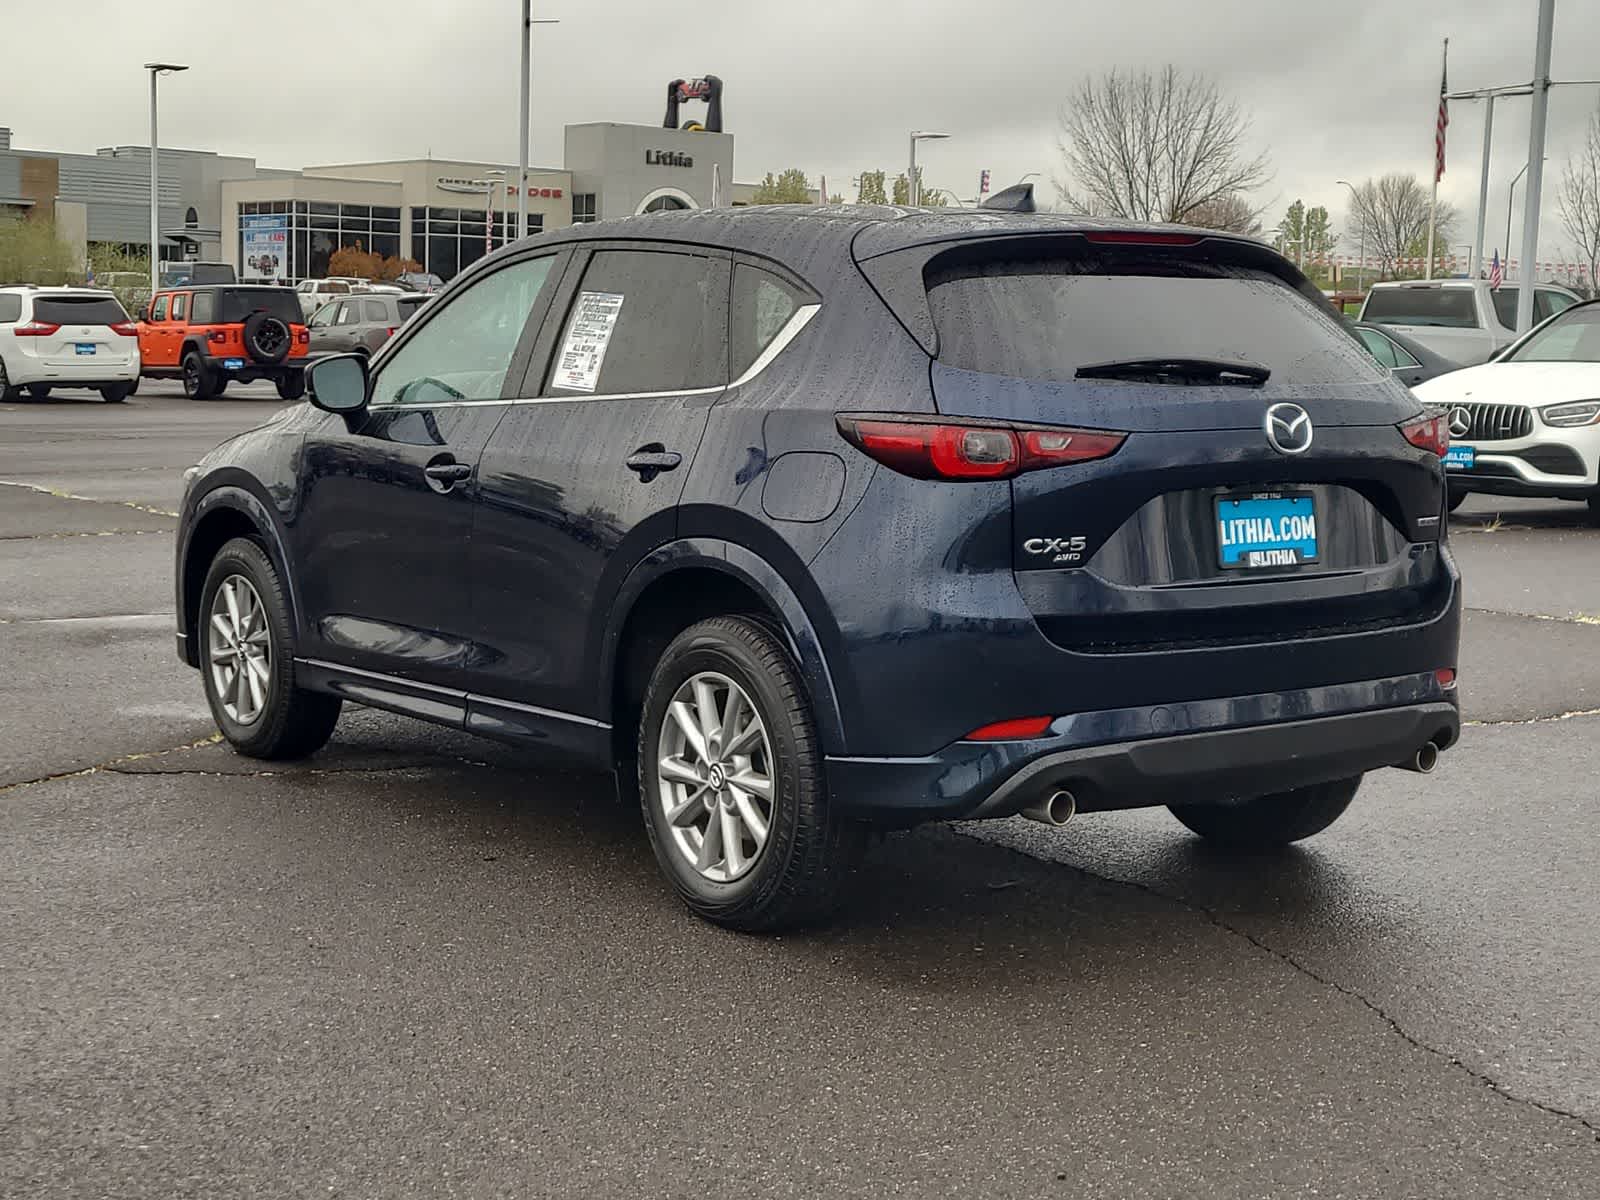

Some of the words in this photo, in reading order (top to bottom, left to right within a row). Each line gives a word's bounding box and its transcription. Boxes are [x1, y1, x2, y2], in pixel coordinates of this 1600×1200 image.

[646, 149, 693, 168] Lithia
[507, 186, 562, 199] DDGE
[1220, 515, 1316, 545] LITHIA.COM
[1023, 536, 1086, 554] CX-5
[1052, 553, 1081, 563] AWD
